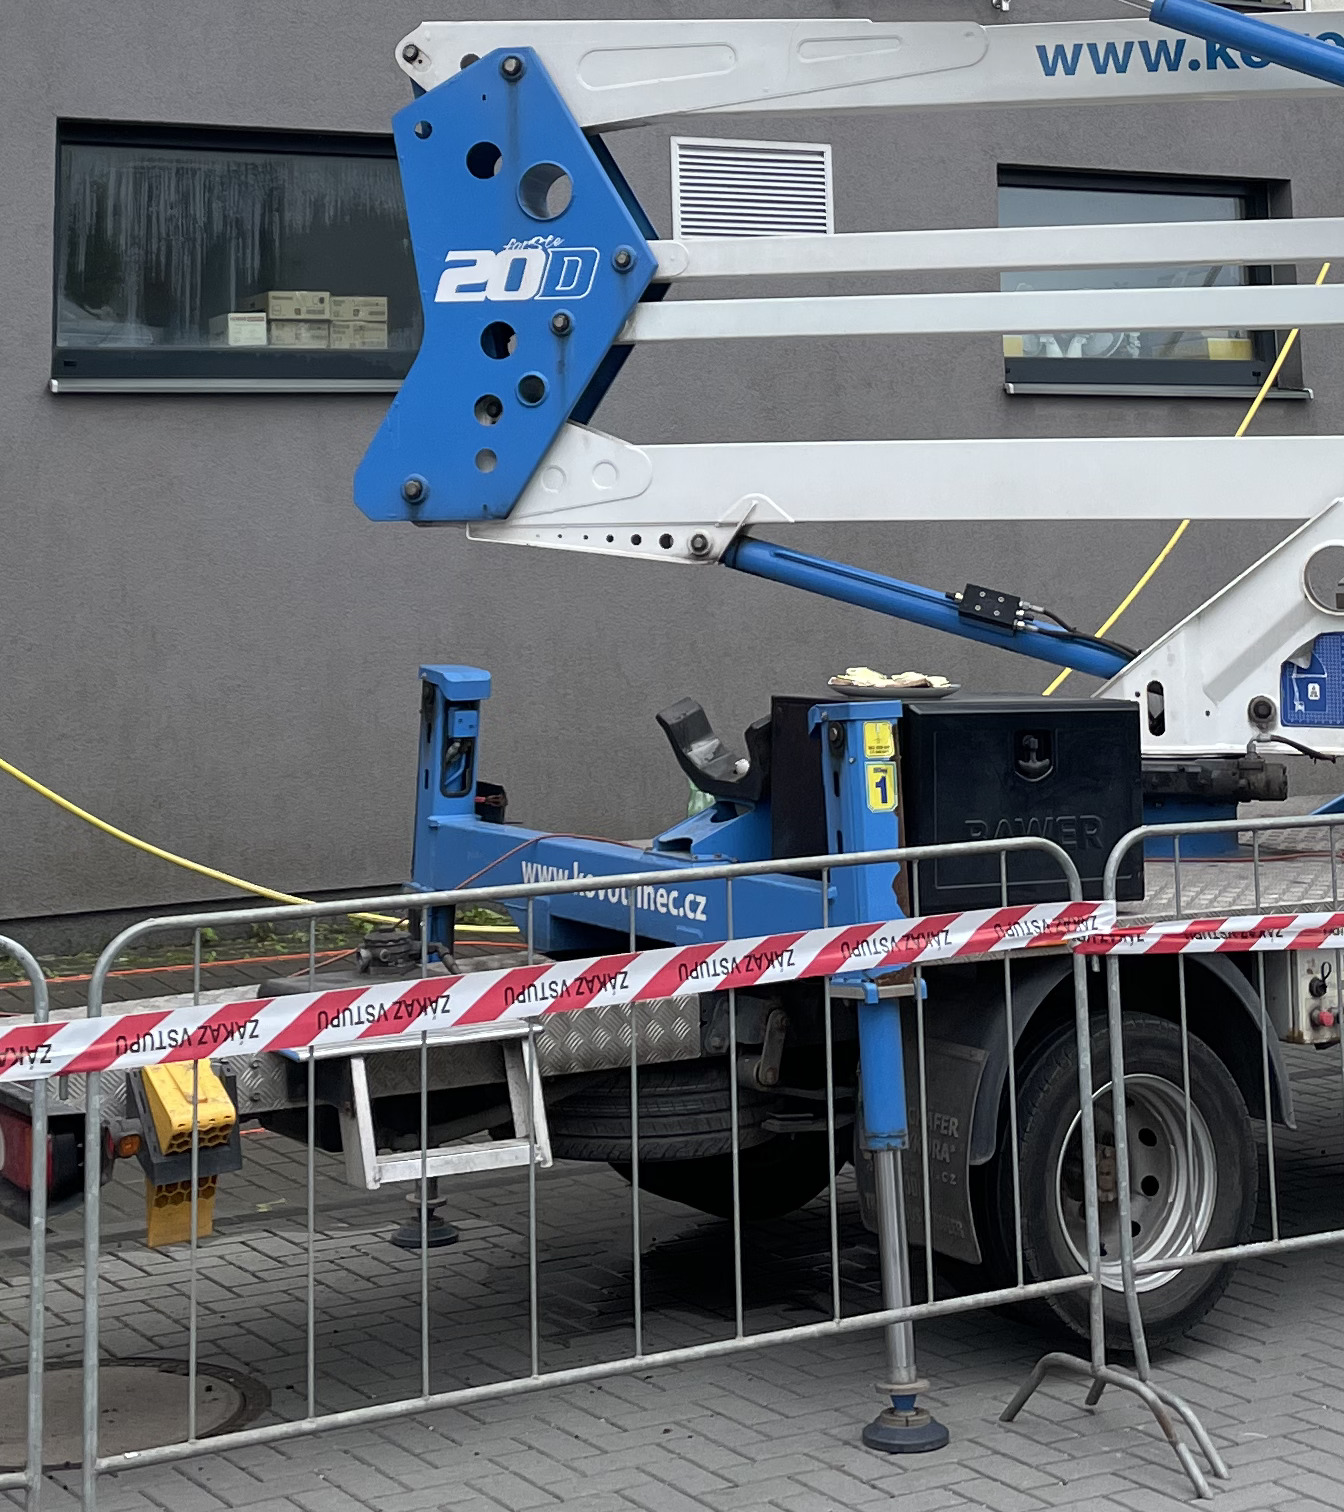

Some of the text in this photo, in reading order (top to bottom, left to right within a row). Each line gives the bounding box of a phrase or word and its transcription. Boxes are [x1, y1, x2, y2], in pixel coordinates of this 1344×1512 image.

[434, 247, 600, 303] 20D
[875, 775, 888, 804] 1
[678, 948, 796, 981] ZÁKAZ VSTUPU
[840, 935, 897, 959] VSTUPU
[504, 971, 629, 1006] ZÁKAZ VSTUPU
[316, 994, 451, 1030] ZÁKAZ VSTUPU
[115, 1019, 260, 1055] ZÁKAZ VSTUPU
